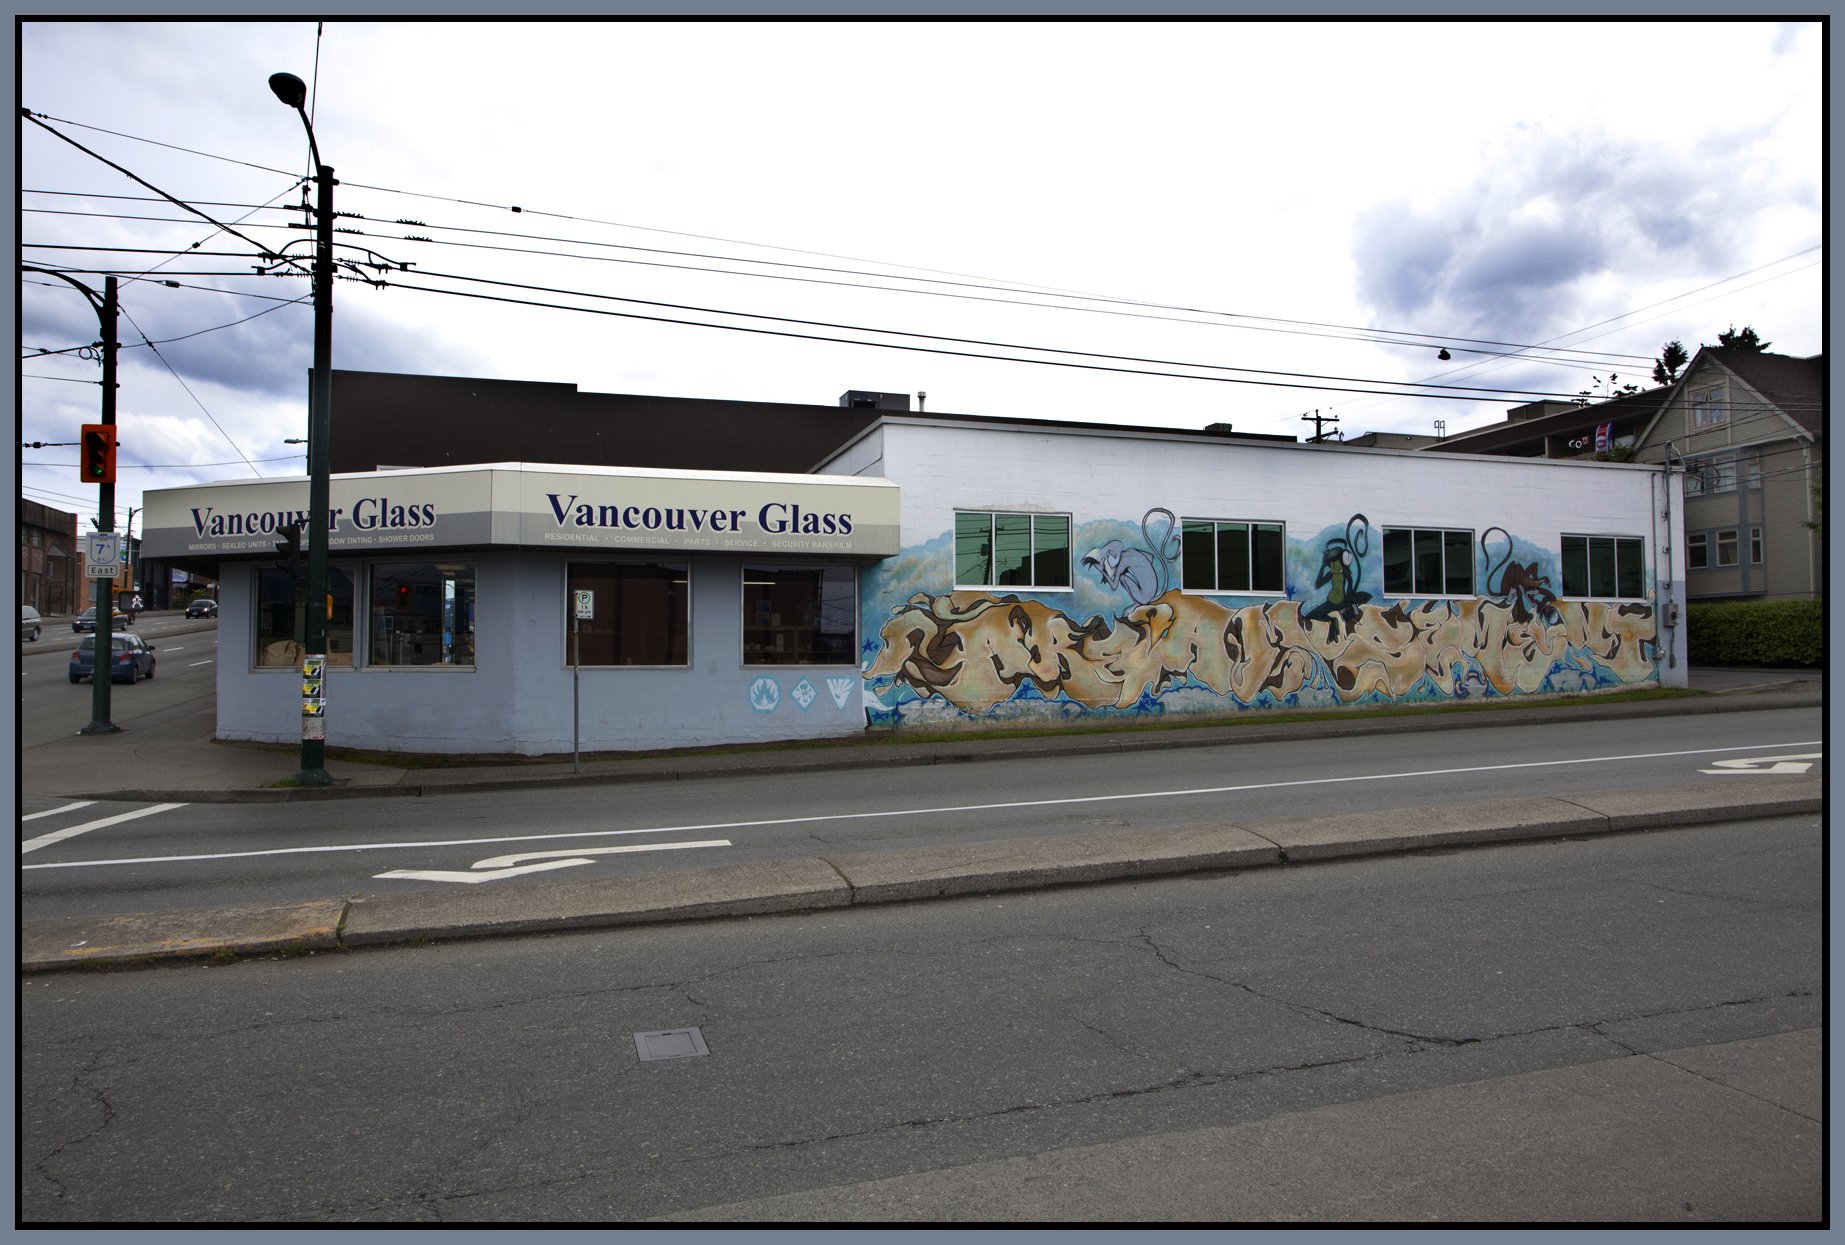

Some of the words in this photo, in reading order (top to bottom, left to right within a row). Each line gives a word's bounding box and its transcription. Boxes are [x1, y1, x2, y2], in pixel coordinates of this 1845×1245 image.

[190, 507, 343, 537] Vancouvr
[352, 497, 435, 530] Glass
[545, 493, 746, 532] Vancouver
[758, 502, 853, 535] Glass
[188, 543, 217, 551] MIRRORS
[221, 541, 247, 550] SEALED
[248, 540, 267, 549] UNITS
[347, 536, 373, 545] TINTING
[378, 535, 407, 543] SHOWER
[409, 533, 435, 542] DOORS
[544, 532, 600, 542] RESIDENTIAL
[614, 535, 670, 545] COMMERCIAL
[684, 538, 711, 546] PARTS
[724, 538, 759, 547] SERVICE
[772, 540, 810, 548] SECURITY
[91, 566, 114, 574] East
